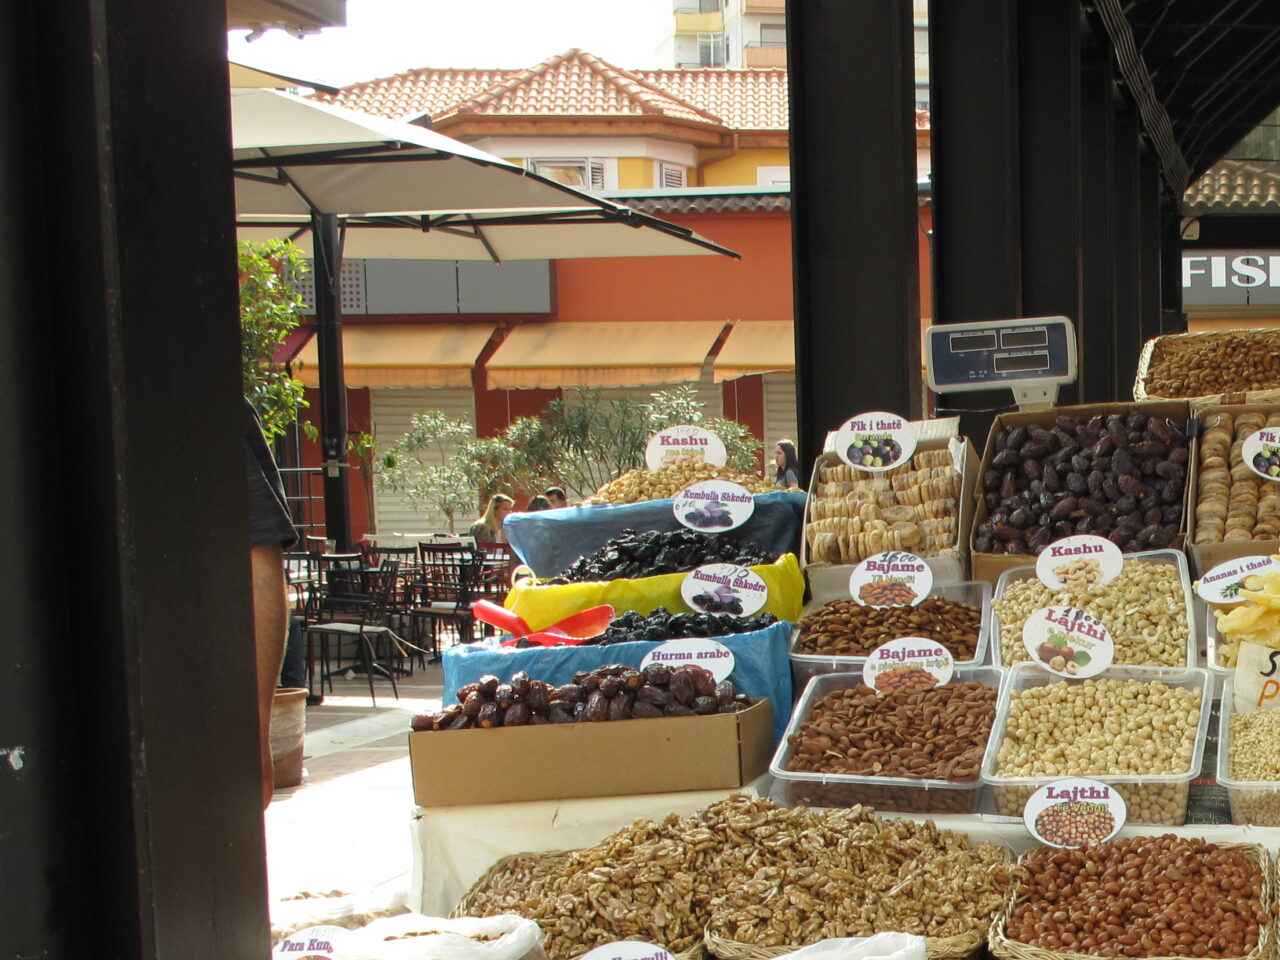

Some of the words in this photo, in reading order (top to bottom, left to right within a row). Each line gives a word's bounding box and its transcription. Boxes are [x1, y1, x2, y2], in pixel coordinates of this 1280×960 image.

[850, 421, 867, 431] Fik
[869, 420, 873, 430] i
[876, 420, 902, 430] thatë
[660, 435, 709, 446] Kashu
[1259, 432, 1276, 442] Fik
[683, 489, 719, 500] Kumbulla
[721, 492, 752, 503] Shkodre
[1051, 543, 1104, 557] Kashu
[865, 560, 925, 574] Bajame
[1203, 568, 1238, 584] Ananas
[1246, 557, 1273, 571] thatë
[693, 570, 731, 585] Kumbulla
[732, 577, 766, 592] Shkodre
[1044, 608, 1107, 641] Lajthi
[652, 651, 692, 661] Hurma
[696, 649, 730, 659] arabe
[879, 647, 943, 662] Bajame
[1046, 787, 1110, 803] Lajthi
[280, 940, 305, 952] Fara
